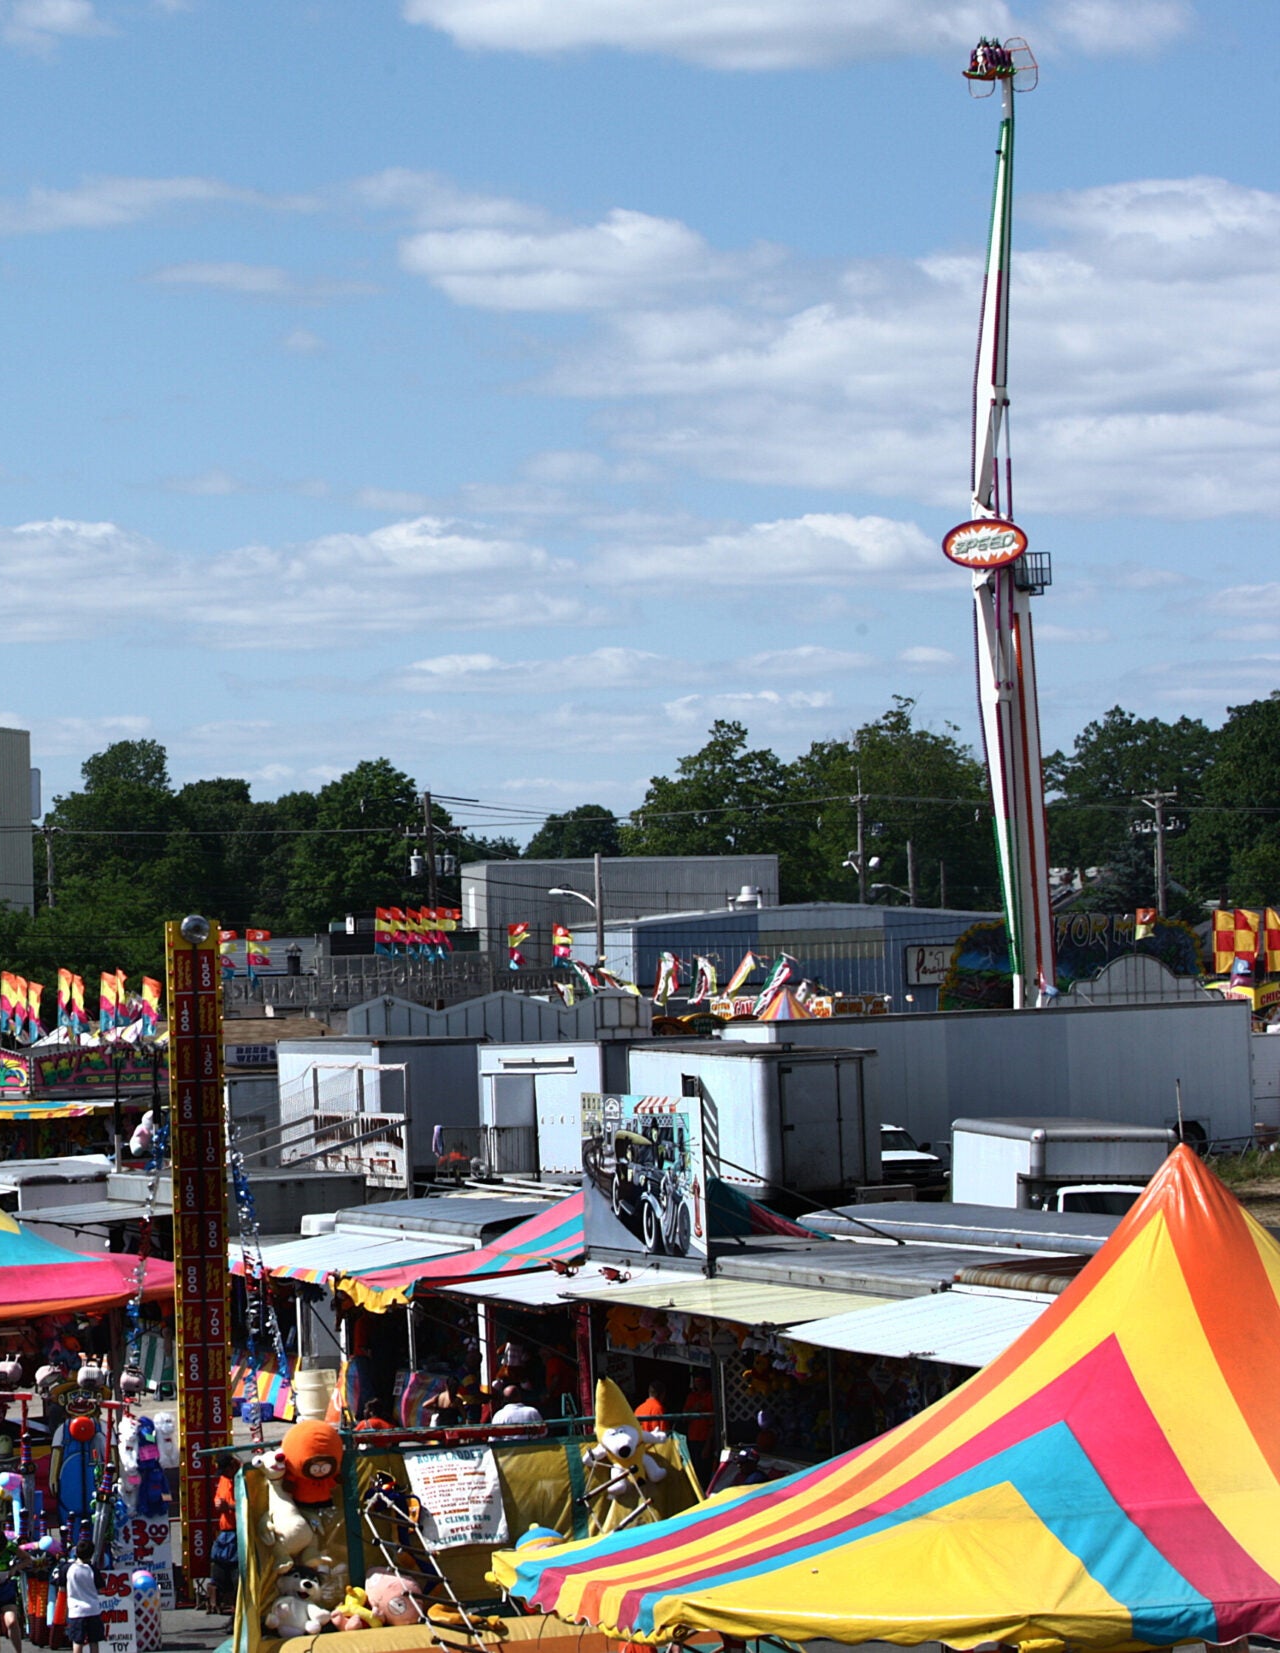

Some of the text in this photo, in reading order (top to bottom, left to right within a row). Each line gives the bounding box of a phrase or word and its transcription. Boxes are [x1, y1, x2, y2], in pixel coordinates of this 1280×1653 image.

[954, 532, 1014, 555] SPEED
[236, 1054, 268, 1062] WINE
[208, 1220, 218, 1248] 900
[187, 1266, 197, 1293] 800
[210, 1308, 220, 1336] 700
[189, 1353, 199, 1382] 600
[212, 1396, 222, 1424] 500
[445, 1514, 471, 1524] CLIMB
[450, 1523, 483, 1534] SPECIAL
[193, 1529, 204, 1557] 200
[109, 1642, 130, 1652] TOY
